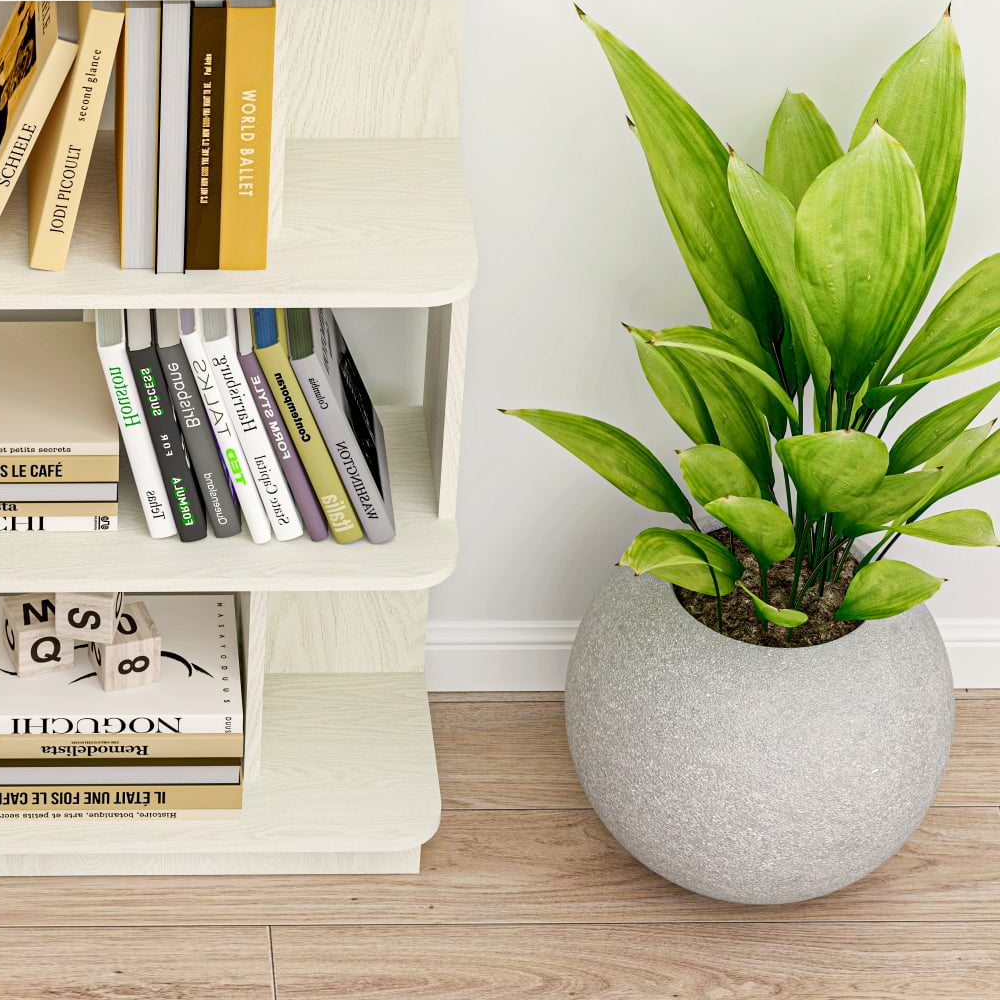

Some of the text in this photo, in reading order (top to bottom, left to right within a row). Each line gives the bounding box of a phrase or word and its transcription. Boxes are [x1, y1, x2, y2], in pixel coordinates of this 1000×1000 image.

[78, 49, 102, 122] second glance
[238, 89, 257, 197] WORLD BALLET
[49, 144, 82, 234] JODI PICOULT
[10, 446, 35, 455] petits
[12, 465, 27, 477] LE
[30, 462, 63, 477] CAFÉ
[68, 607, 101, 630] S
[30, 636, 62, 663] Q
[118, 655, 150, 675] 8
[11, 716, 183, 734] NOGUCHI
[41, 745, 149, 756] Remodelista
[32, 791, 47, 804] LE
[51, 791, 80, 804] FOIS
[84, 791, 110, 804] UNE
[114, 791, 150, 807] ÉTAIT
[154, 791, 166, 804] IL
[22, 811, 49, 819] petits
[85, 811, 134, 819] botanique,
[136, 811, 177, 819] Histoire,
